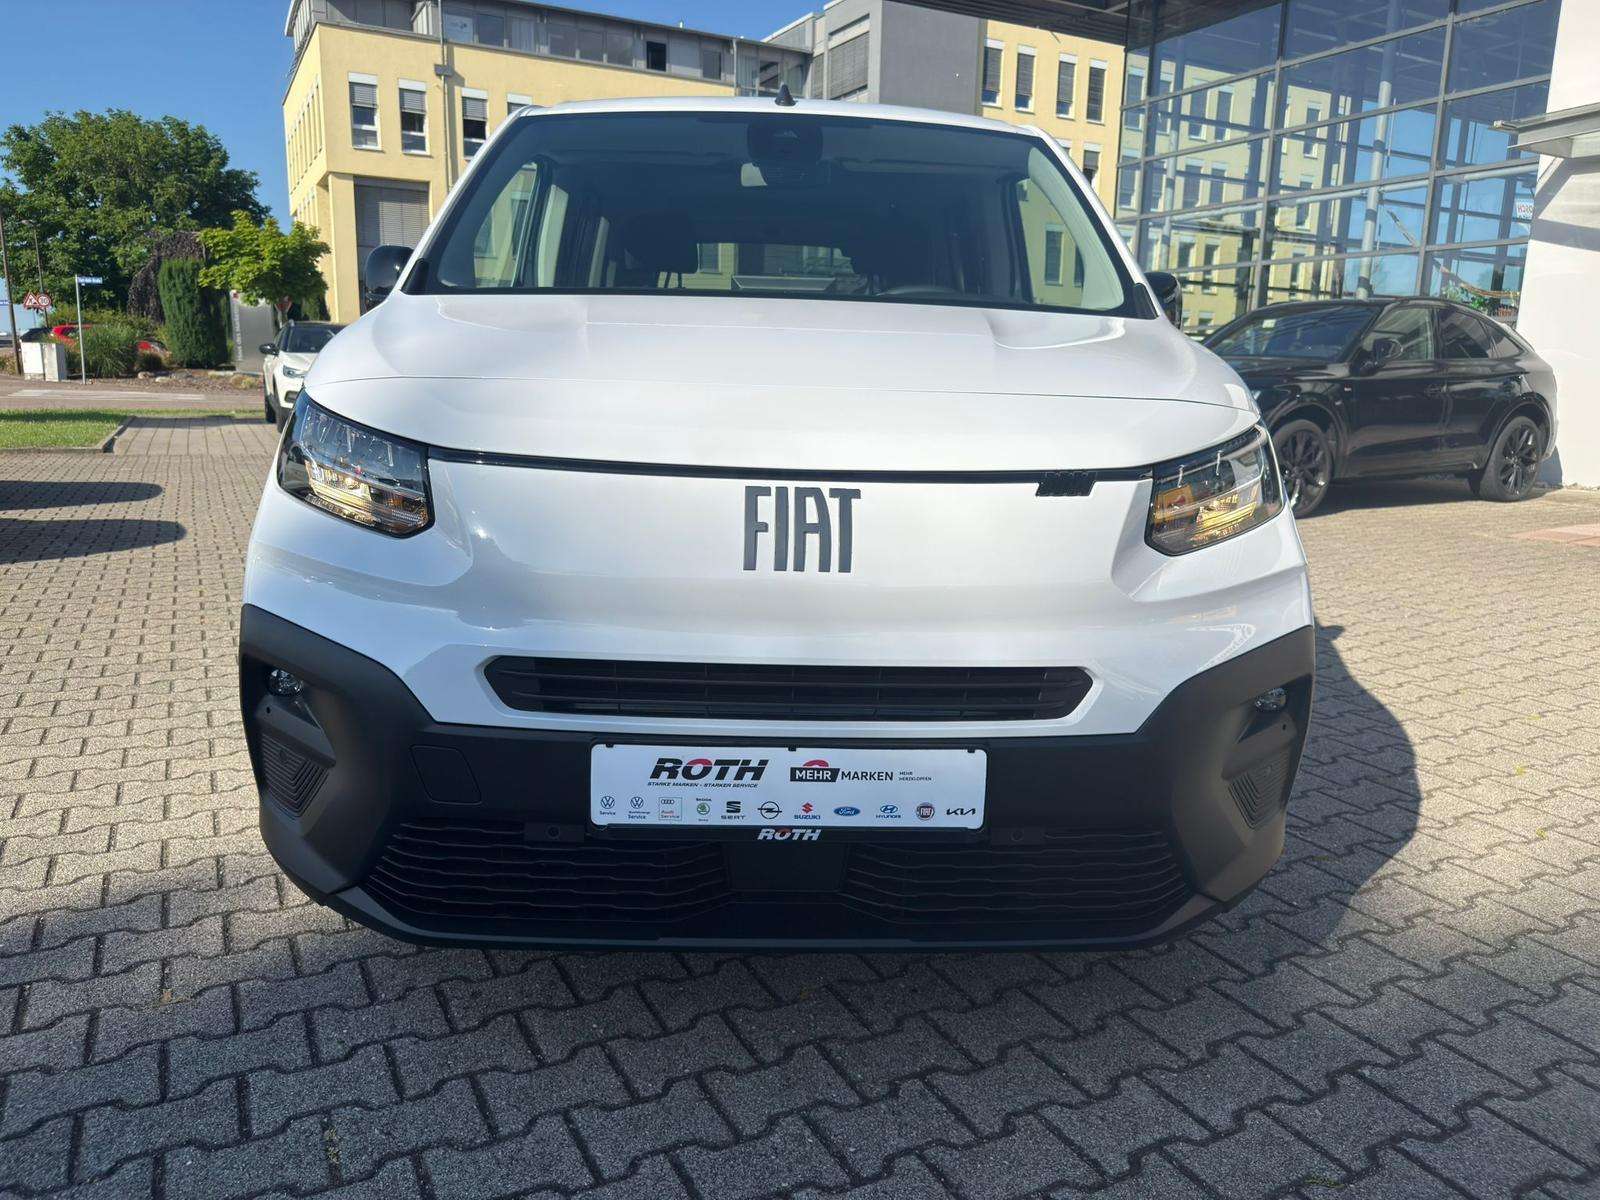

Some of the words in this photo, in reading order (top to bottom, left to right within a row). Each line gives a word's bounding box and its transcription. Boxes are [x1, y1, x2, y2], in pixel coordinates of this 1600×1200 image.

[743, 486, 861, 573] FIAT
[649, 758, 769, 780] ROTH
[795, 770, 831, 780] MEHR
[841, 771, 893, 780] MARKEN
[757, 828, 821, 840] ROTH
